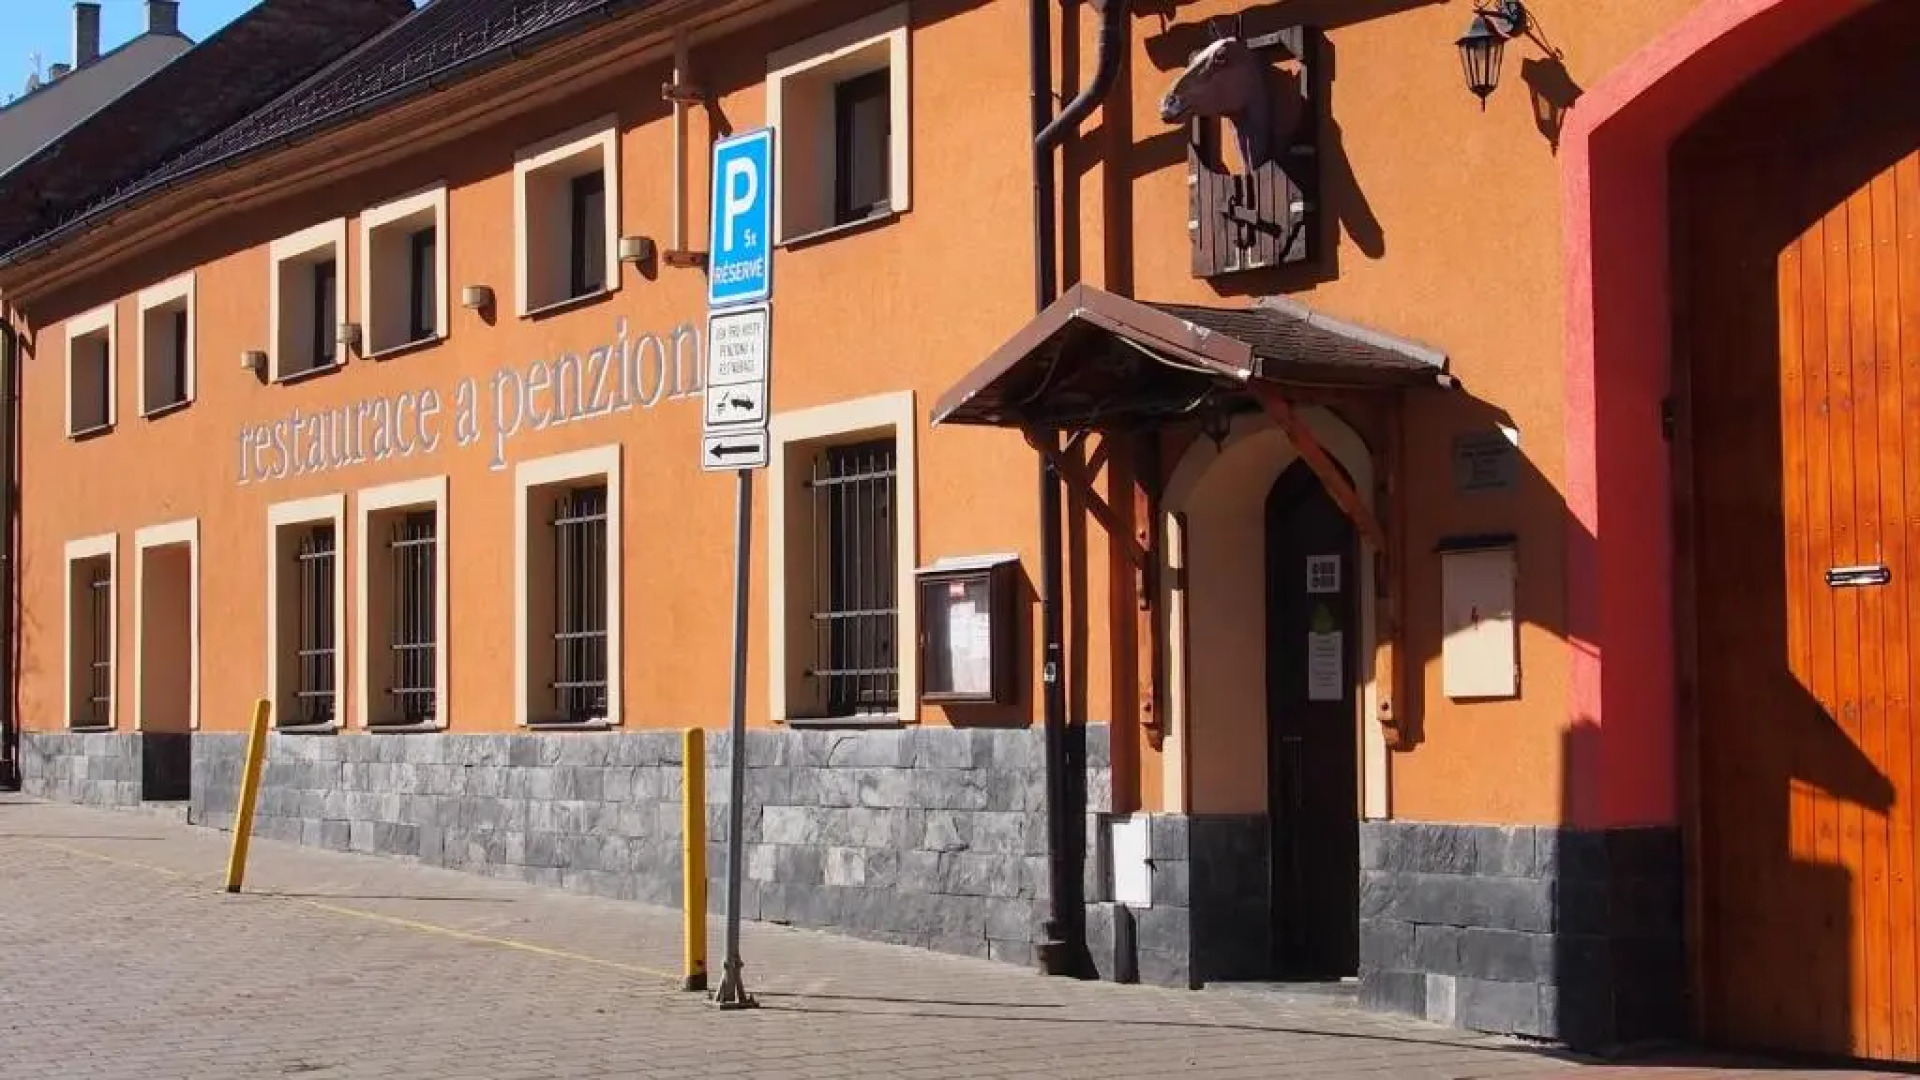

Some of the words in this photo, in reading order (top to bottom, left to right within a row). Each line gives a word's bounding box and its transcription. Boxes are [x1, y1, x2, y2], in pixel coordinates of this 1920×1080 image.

[723, 156, 758, 252] P
[237, 388, 441, 486] restaurace
[455, 376, 480, 446] a
[488, 316, 705, 470] penzion
